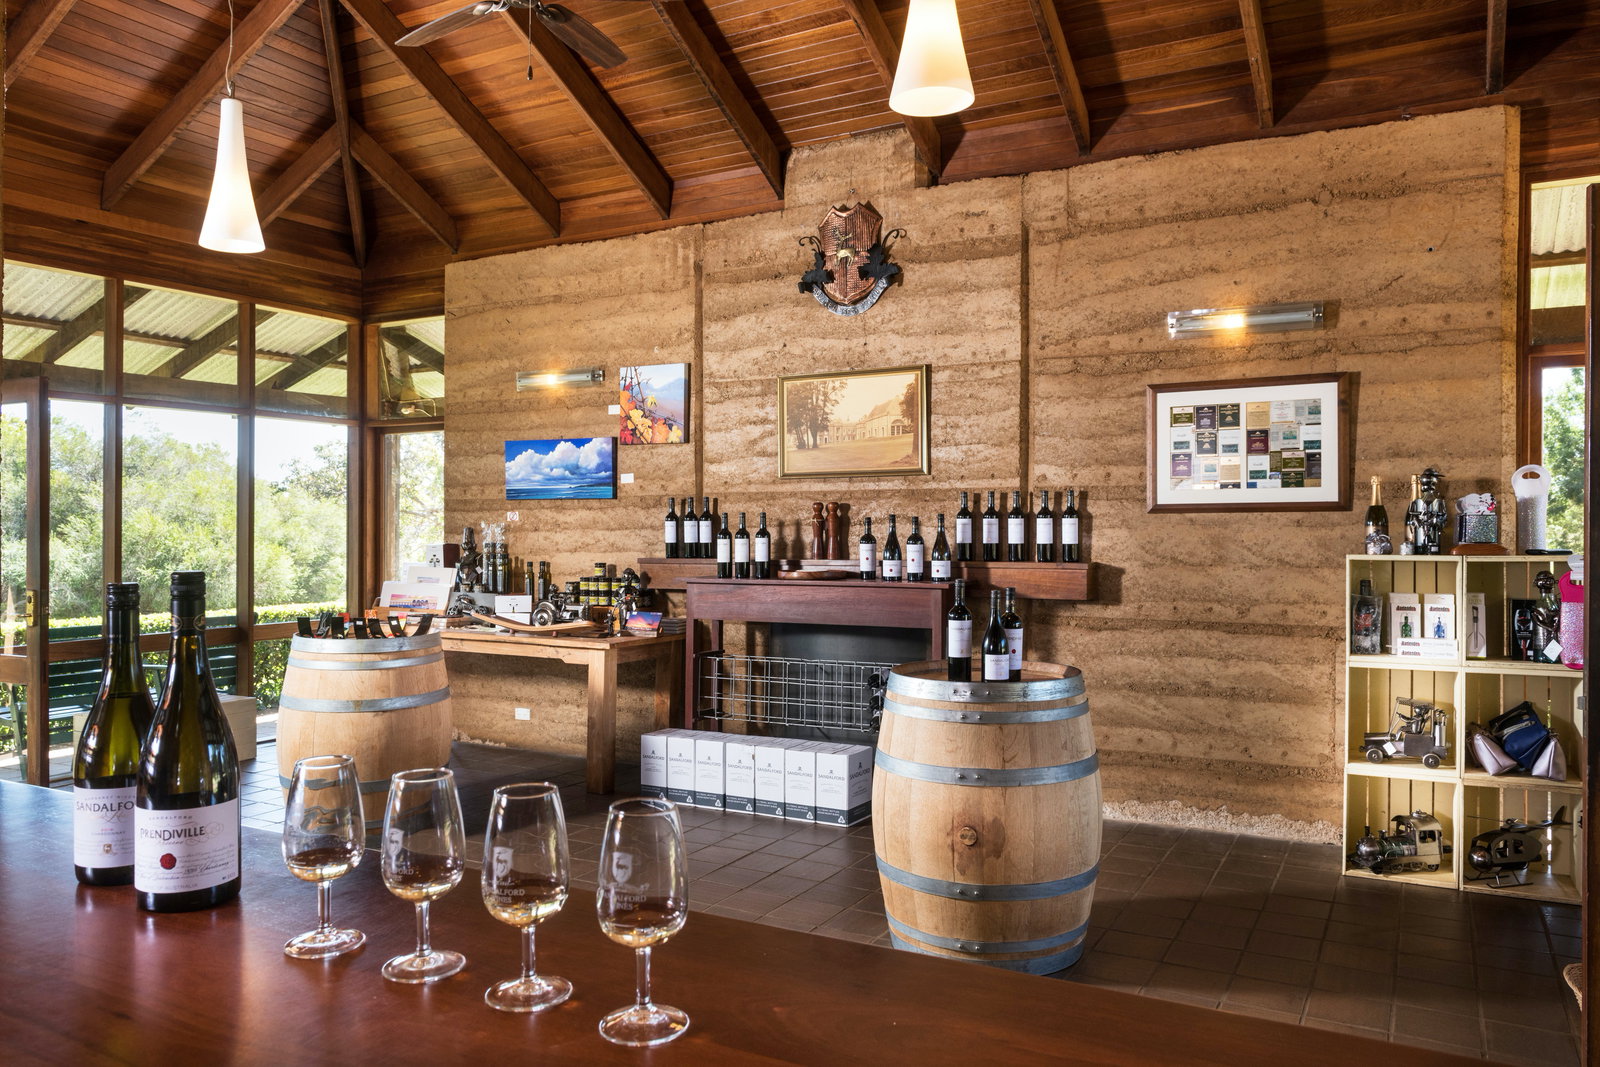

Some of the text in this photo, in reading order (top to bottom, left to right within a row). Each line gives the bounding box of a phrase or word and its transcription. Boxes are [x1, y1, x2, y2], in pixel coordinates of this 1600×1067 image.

[757, 767, 783, 775] SANDALFORD
[787, 770, 813, 778] SANDALFORD
[849, 768, 871, 780] SANDALFORD
[818, 773, 846, 781] SANDALFORD
[76, 800, 135, 812] SANDALFO
[140, 826, 206, 841] PRENDIVILLE
